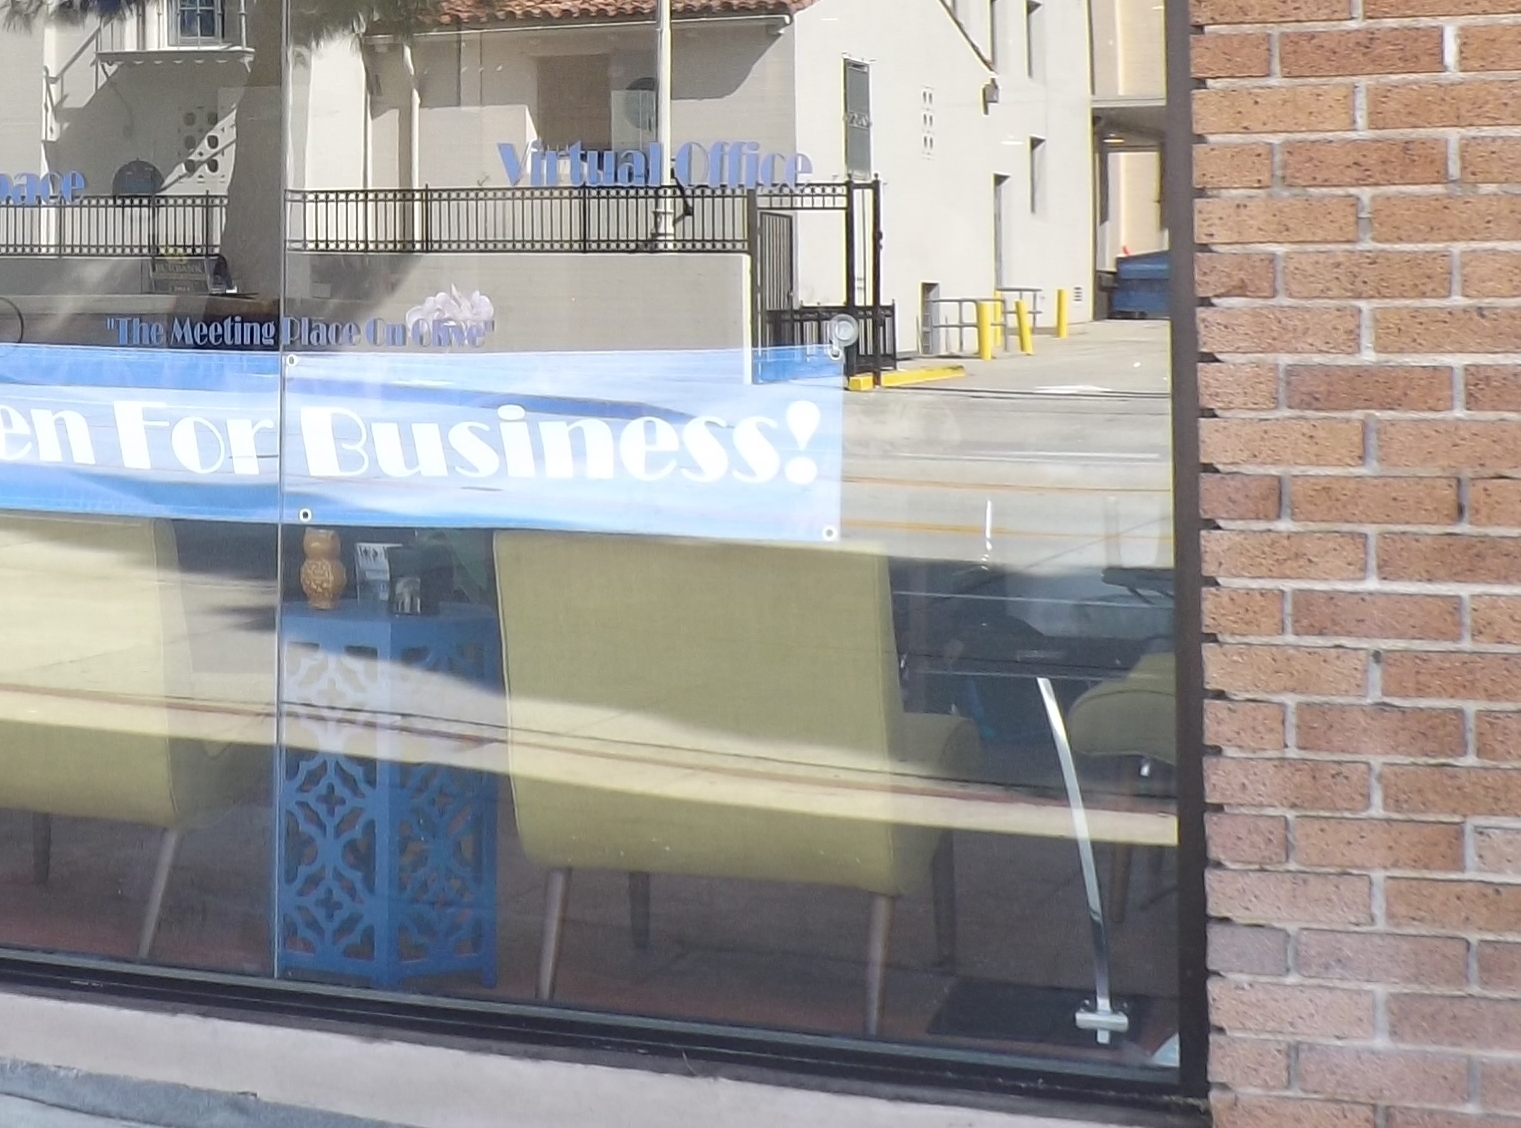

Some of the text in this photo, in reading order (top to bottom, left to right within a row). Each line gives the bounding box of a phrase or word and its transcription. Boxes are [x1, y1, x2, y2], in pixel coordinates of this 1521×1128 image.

[496, 139, 814, 190] Virtual Office
[169, 316, 276, 346] Meeting
[282, 317, 362, 347] Place
[366, 318, 408, 347] On
[113, 400, 275, 476] For
[300, 400, 822, 485] Business!
